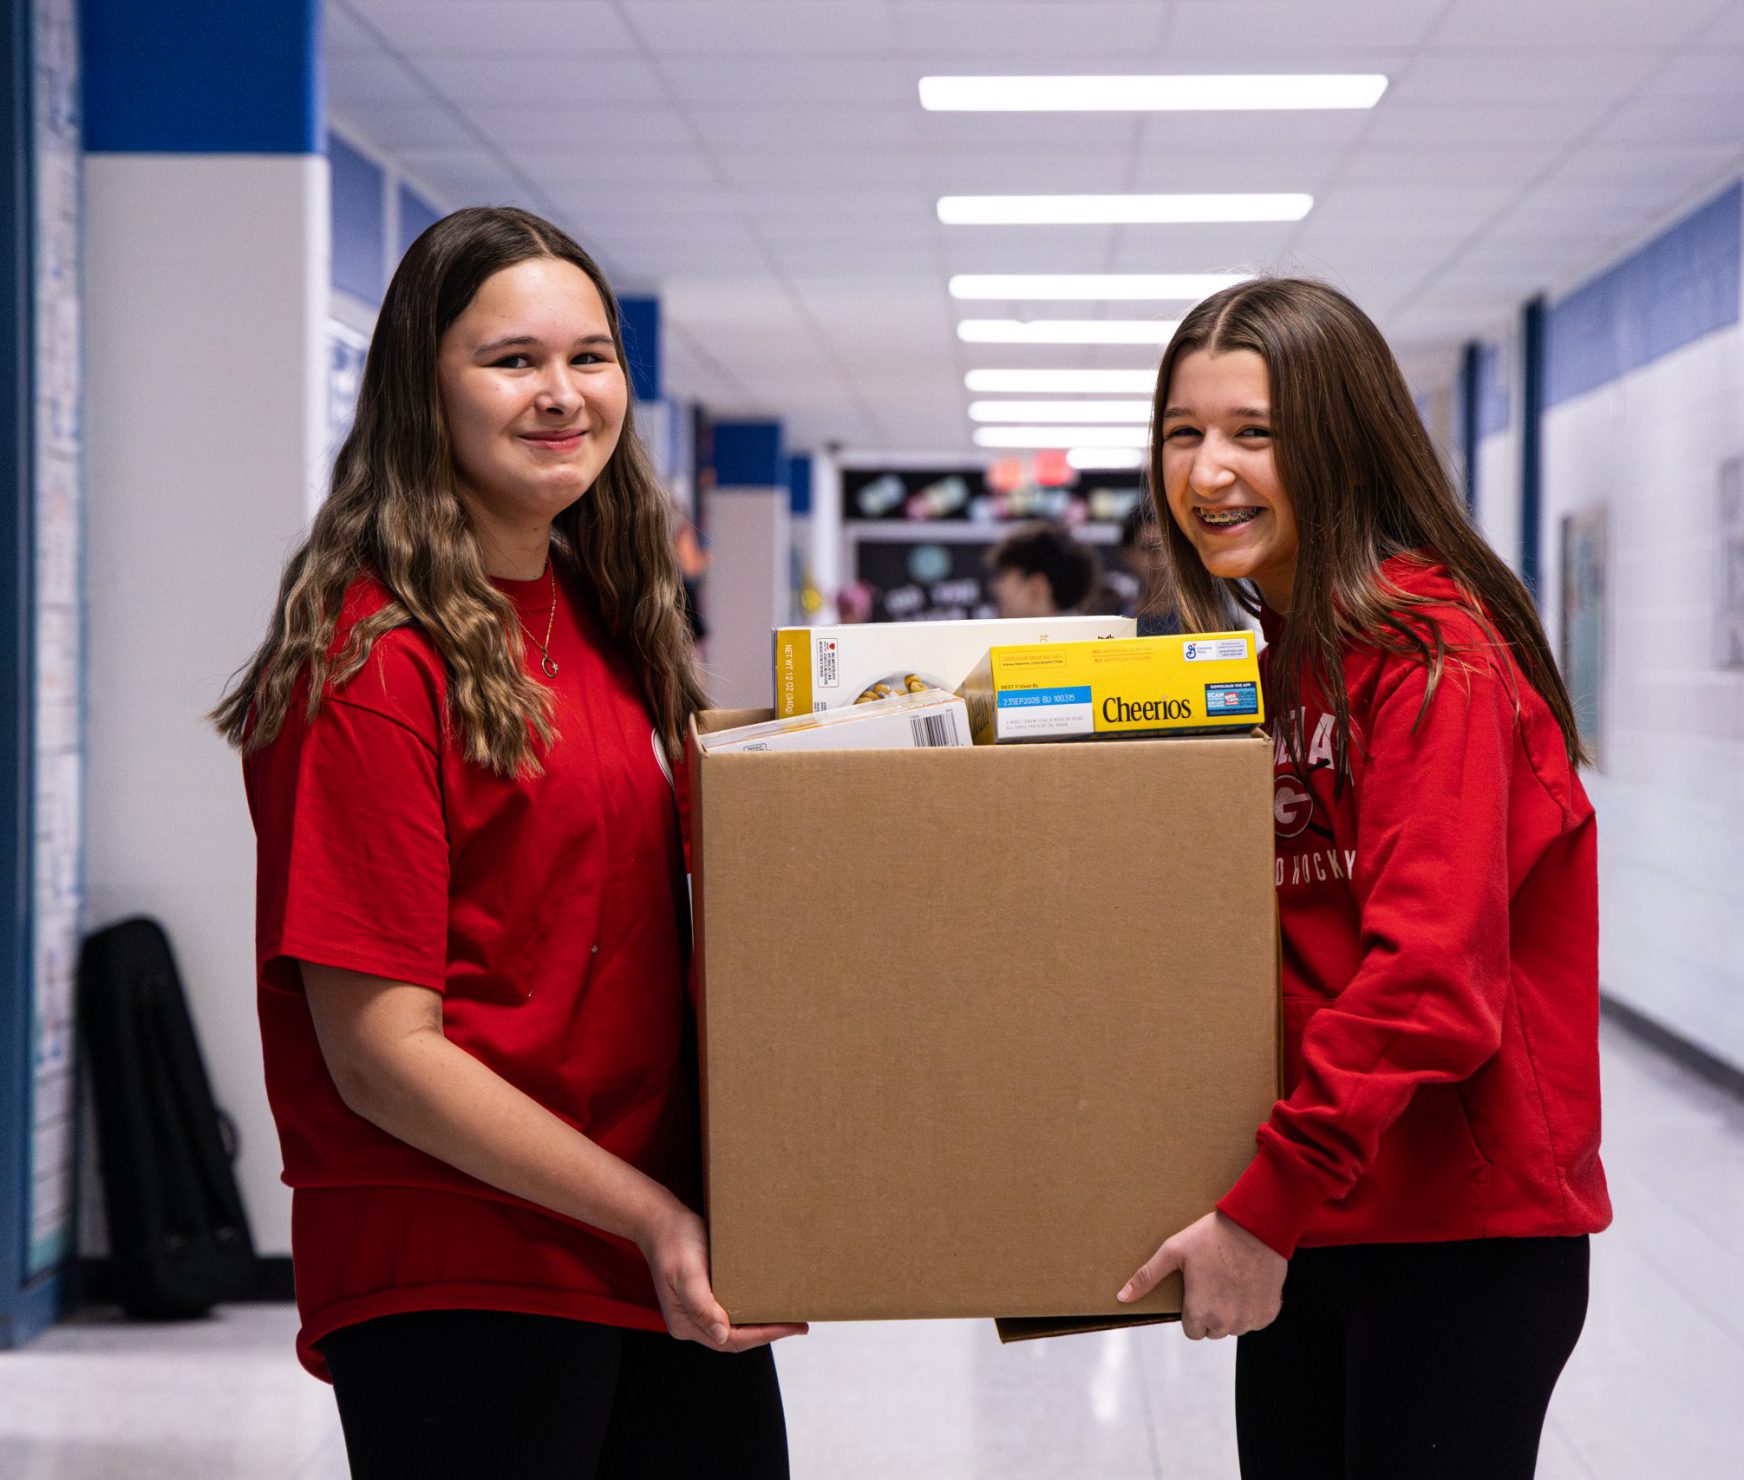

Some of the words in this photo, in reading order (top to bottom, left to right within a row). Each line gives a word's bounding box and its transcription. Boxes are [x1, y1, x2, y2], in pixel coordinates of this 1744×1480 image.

[785, 659, 793, 670] WT
[786, 672, 794, 681] 12
[786, 682, 794, 692] OZ
[1102, 695, 1192, 723] Cheerios
